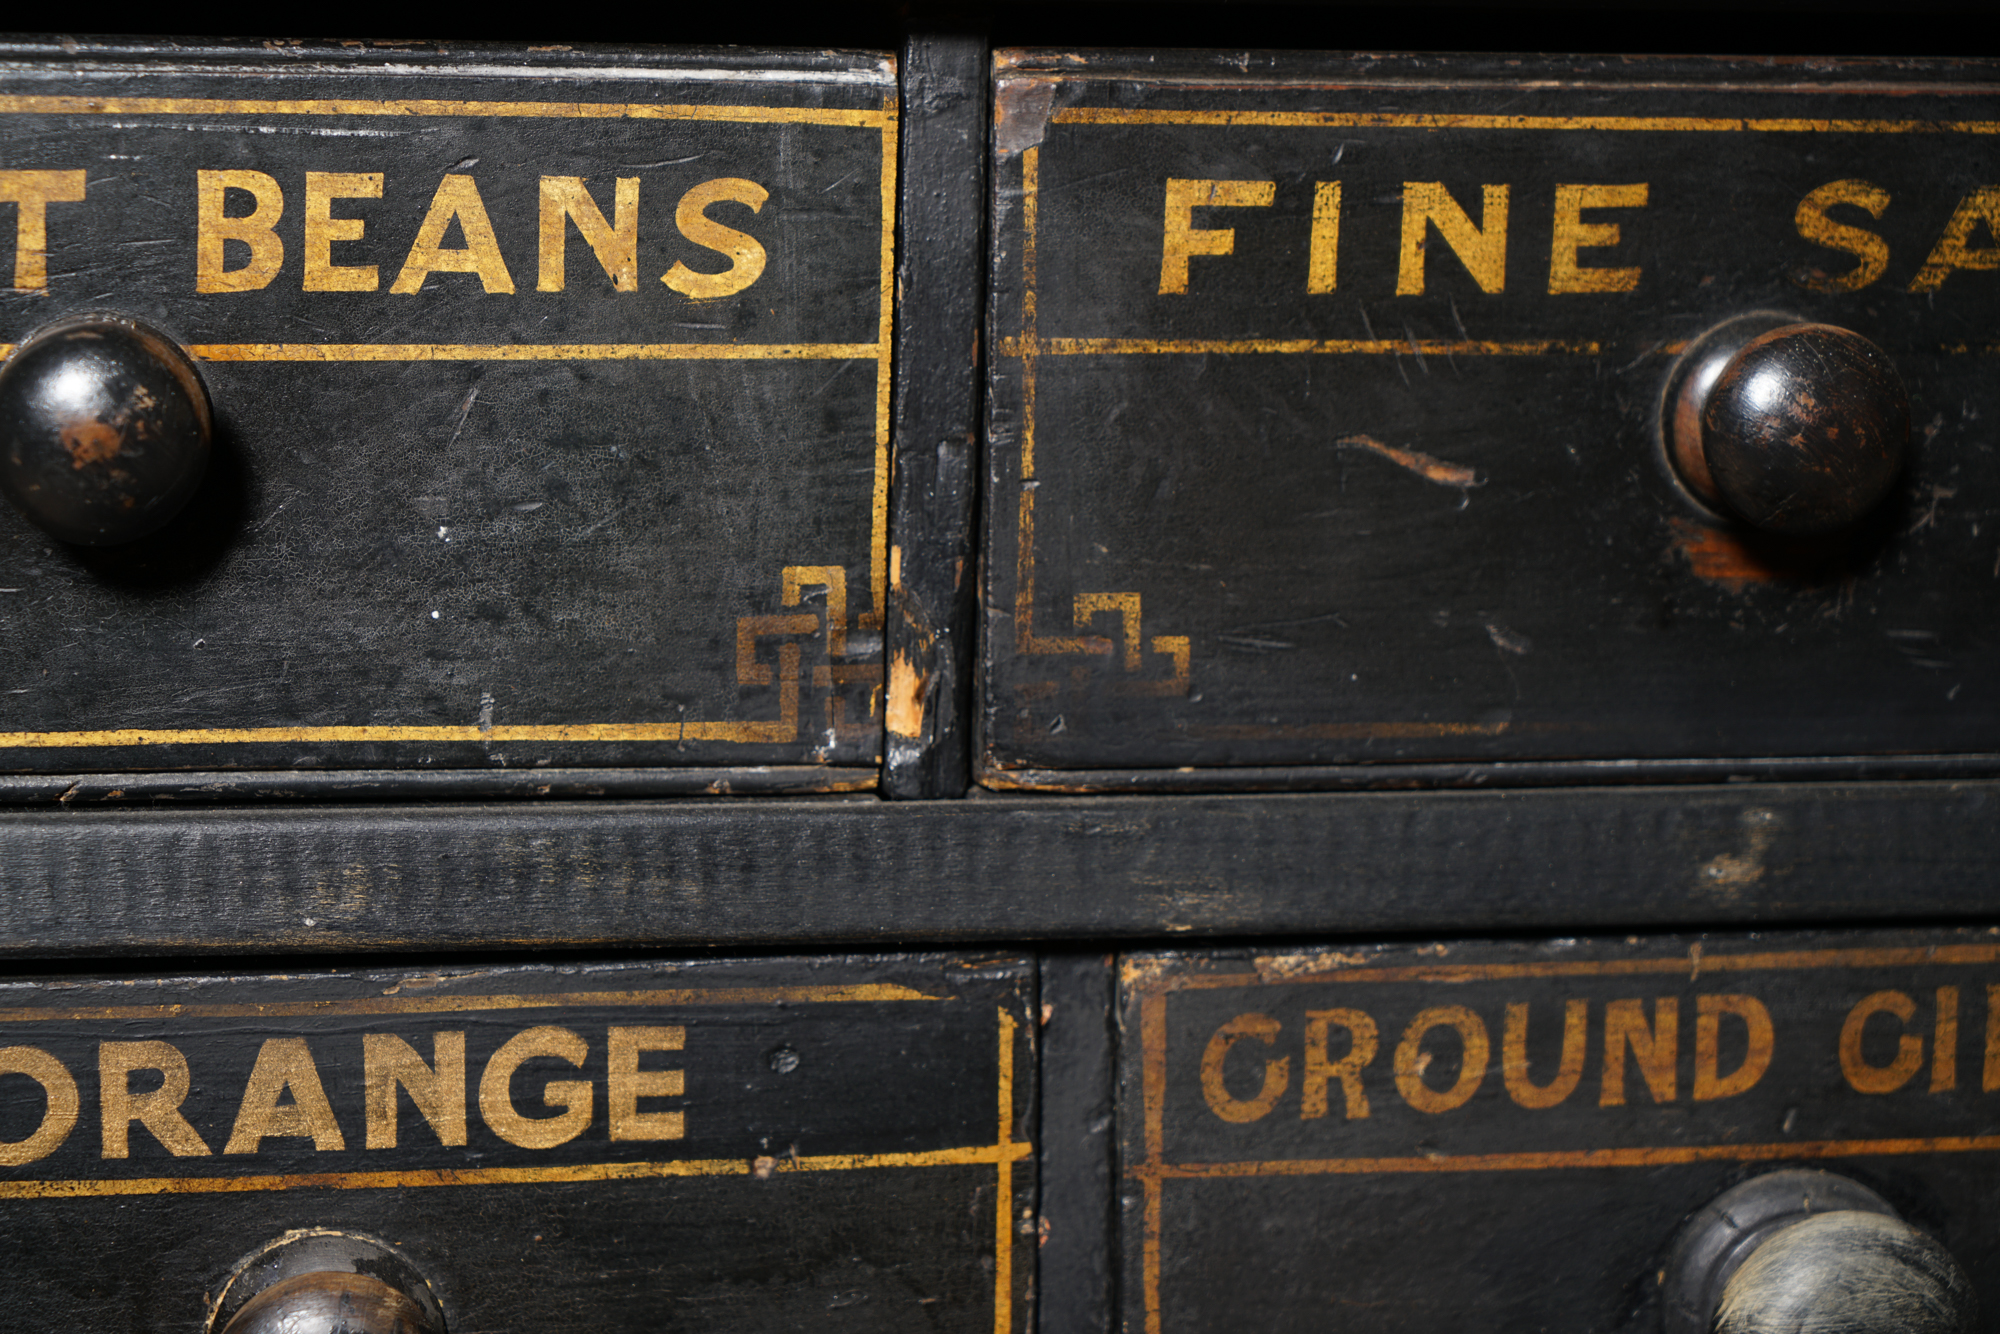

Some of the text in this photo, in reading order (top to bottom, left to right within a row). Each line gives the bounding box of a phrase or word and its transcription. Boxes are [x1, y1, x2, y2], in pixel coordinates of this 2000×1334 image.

[196, 169, 770, 299] BEANS
[1158, 177, 2000, 296] FINE SA
[0, 1025, 687, 1167] ORANGE
[1200, 983, 2000, 1124] GROUND GI
